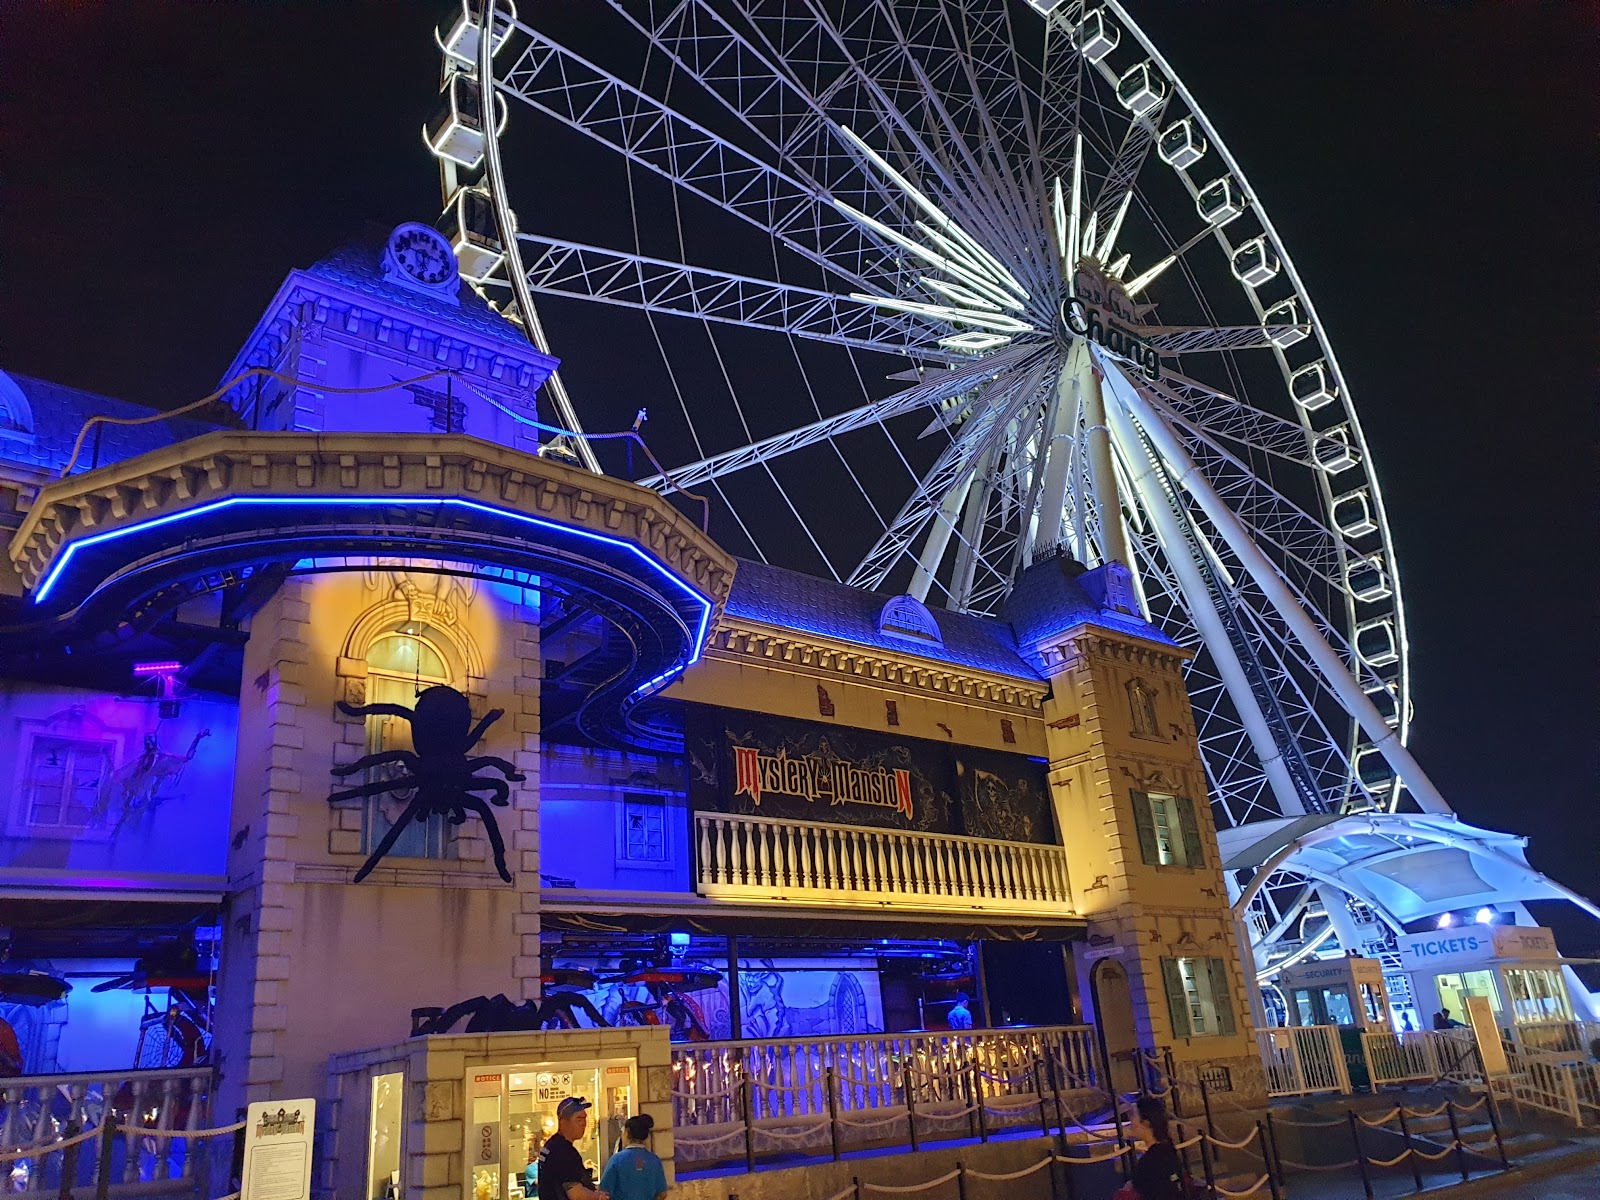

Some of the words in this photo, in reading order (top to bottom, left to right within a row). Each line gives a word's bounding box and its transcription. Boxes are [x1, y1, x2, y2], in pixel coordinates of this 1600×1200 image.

[1062, 297, 1160, 380] Chang
[1411, 937, 1479, 957] TICKETS
[1305, 968, 1342, 979] SECURITY
[539, 1088, 549, 1100] NO
